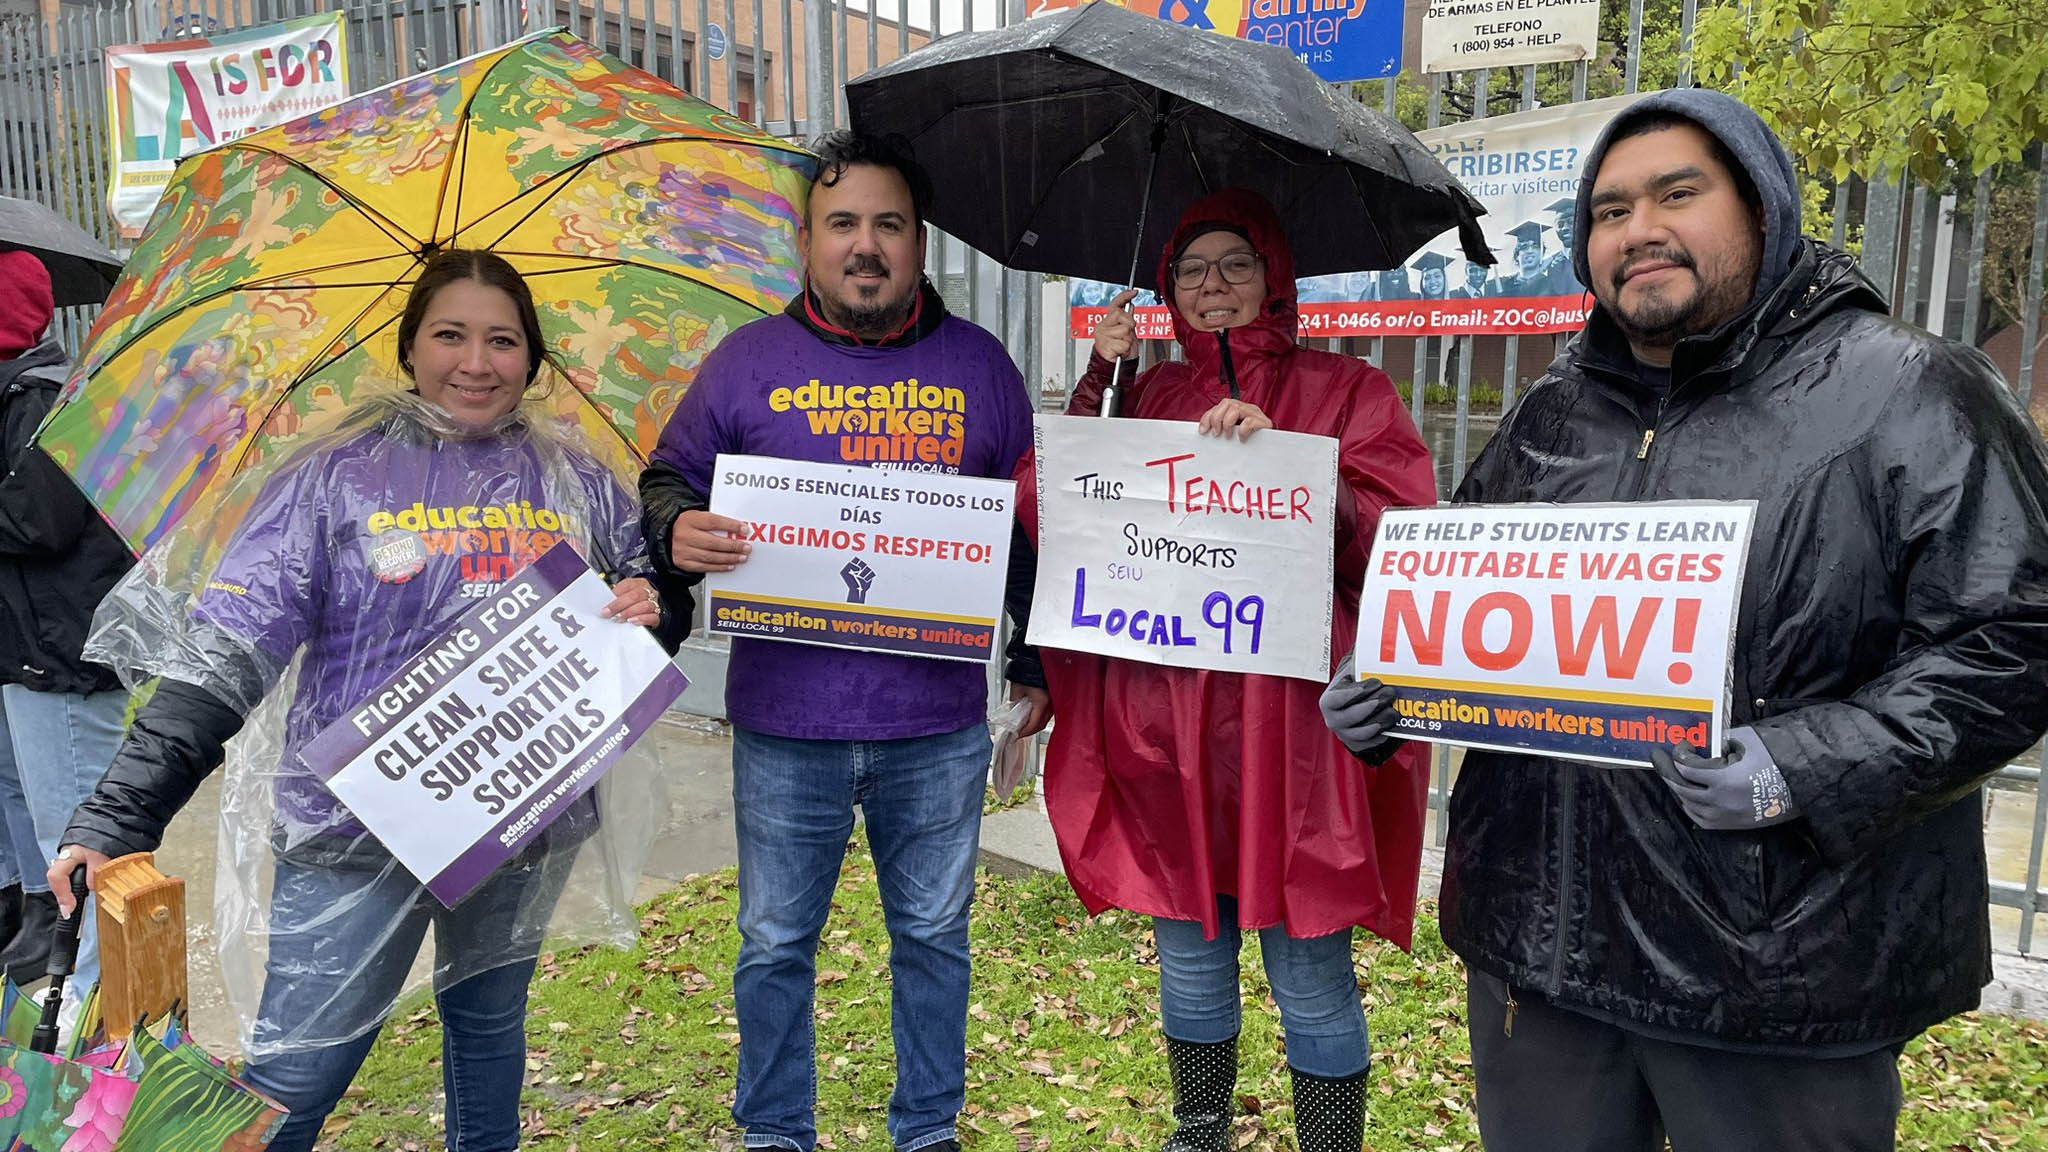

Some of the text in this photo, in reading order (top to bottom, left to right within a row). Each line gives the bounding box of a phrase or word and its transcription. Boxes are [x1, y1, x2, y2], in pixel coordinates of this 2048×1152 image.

[1429, 0, 1597, 19] DE ARMAS EN EL PLAN
[1474, 19, 1542, 35] TELEFONO
[1246, 13, 1346, 48] center
[1452, 44, 1458, 53] 1
[1462, 40, 1490, 54] (800)
[1494, 38, 1515, 49] 954
[1527, 33, 1562, 46] HELP
[210, 53, 248, 96] IS
[253, 39, 335, 92] FOR
[1087, 314, 1107, 324] FO
[1298, 312, 1381, 329] 241-0466
[1385, 311, 1425, 328] or/o
[1431, 308, 1488, 327] Email:
[769, 378, 965, 413] education
[806, 403, 965, 438] workers
[840, 428, 964, 467] united
[905, 463, 944, 474] LOCAL
[946, 466, 960, 475] 99
[724, 471, 1005, 512] SOMOS ESENCIALES TODOS LOS
[1074, 454, 1313, 524] THIS TEACHER
[367, 500, 582, 535] education
[840, 506, 882, 524] DÍAS
[1384, 521, 1738, 543] WE HELP STUDENTS LEARN
[374, 538, 415, 561] BEYOND
[419, 525, 564, 555] worke
[728, 521, 992, 564] XIGIMOS RESPETO!
[1123, 523, 1237, 569] SUPPORTS
[378, 551, 416, 570] RECOVERY
[1107, 563, 1143, 581] SEIU
[1379, 550, 1725, 583] EQUITABLE WAGES
[717, 606, 990, 648] education workers united
[717, 620, 784, 634] SEIU LOCAL 99
[1071, 568, 1265, 655] LOCAL 99
[1379, 588, 1702, 686] NOW!
[352, 582, 541, 737] FIGHTING FOR
[374, 606, 586, 781] CLEAN, SAFE &
[420, 647, 600, 802] SUPPORTIVE
[1428, 721, 1442, 731] 99
[1494, 707, 1604, 737] workers
[1610, 715, 1707, 748] united
[473, 698, 605, 816] SCHOOLS
[499, 723, 630, 844] education workers united
